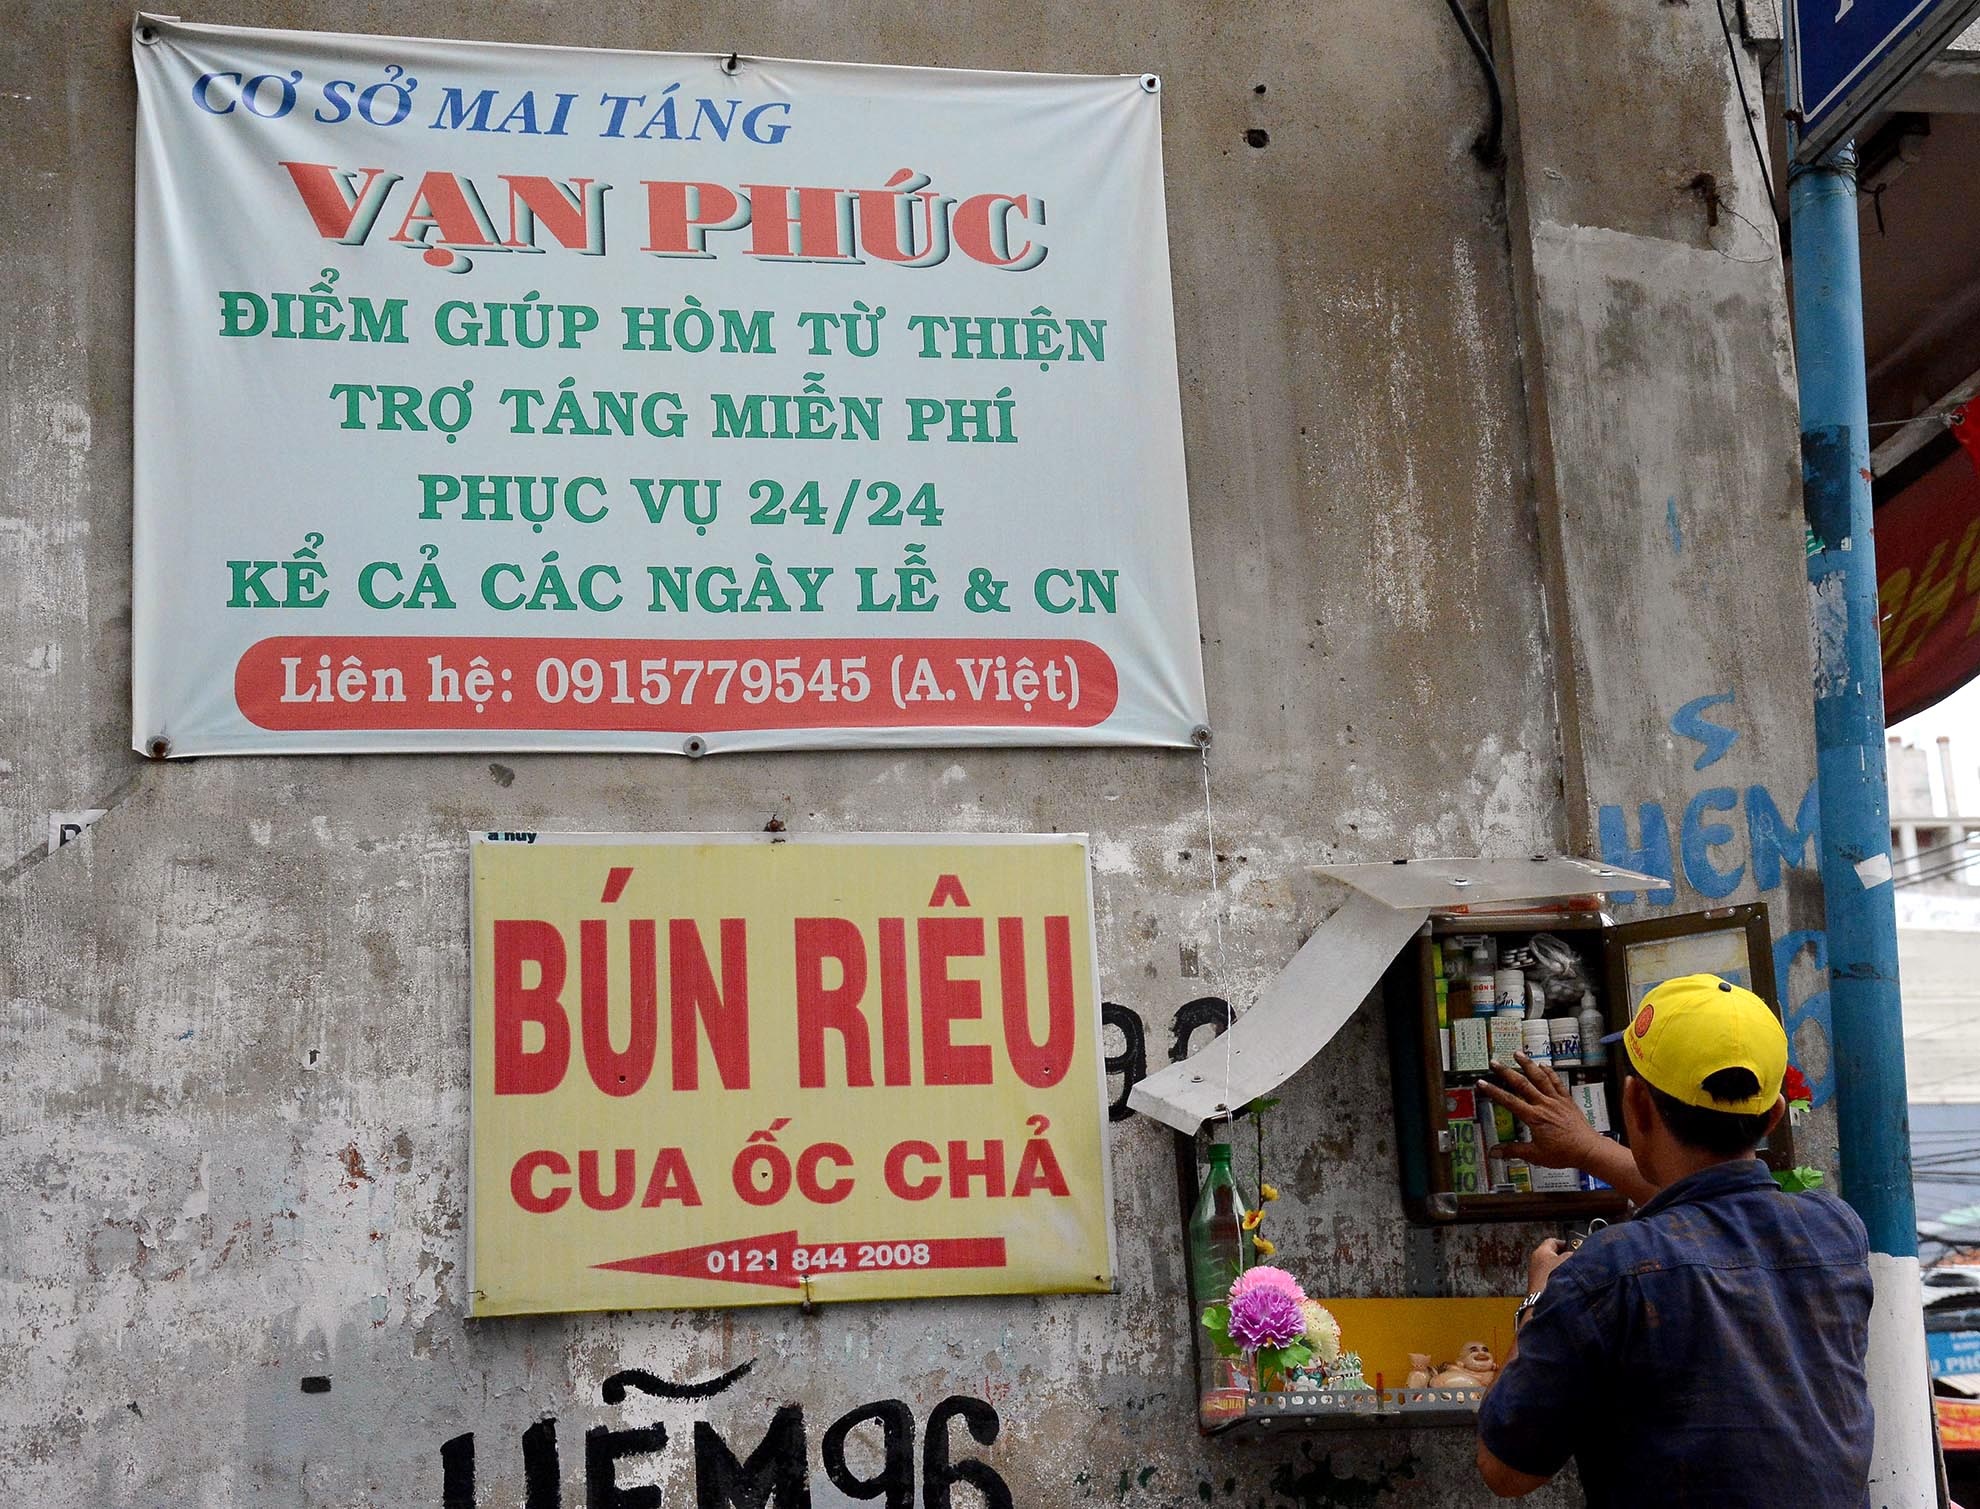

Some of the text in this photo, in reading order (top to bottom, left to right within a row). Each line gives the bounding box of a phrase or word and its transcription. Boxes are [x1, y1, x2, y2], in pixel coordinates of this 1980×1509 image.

[192, 64, 792, 145] CƠ SỞ MAI TÁNG
[279, 160, 1049, 274] VẠN PHÚC
[219, 268, 1106, 373] ĐIỂM GIÚP HÒM TỪ THIỆN
[330, 372, 1018, 444] TRỢ TÁNG MIỄN PHÍ
[418, 474, 944, 537] PHỤC VỤ 24/24
[226, 532, 1120, 615] KỂ CẢ CÁC NGÀY LỄ & CN
[280, 654, 1080, 714] Liên hệ: 0915779545 (A.Việt)
[494, 867, 1075, 1098] BÚN RIÊU
[511, 1114, 1072, 1214] CUA ỐC CHẢ
[707, 1243, 930, 1273] 0121 844 2008
